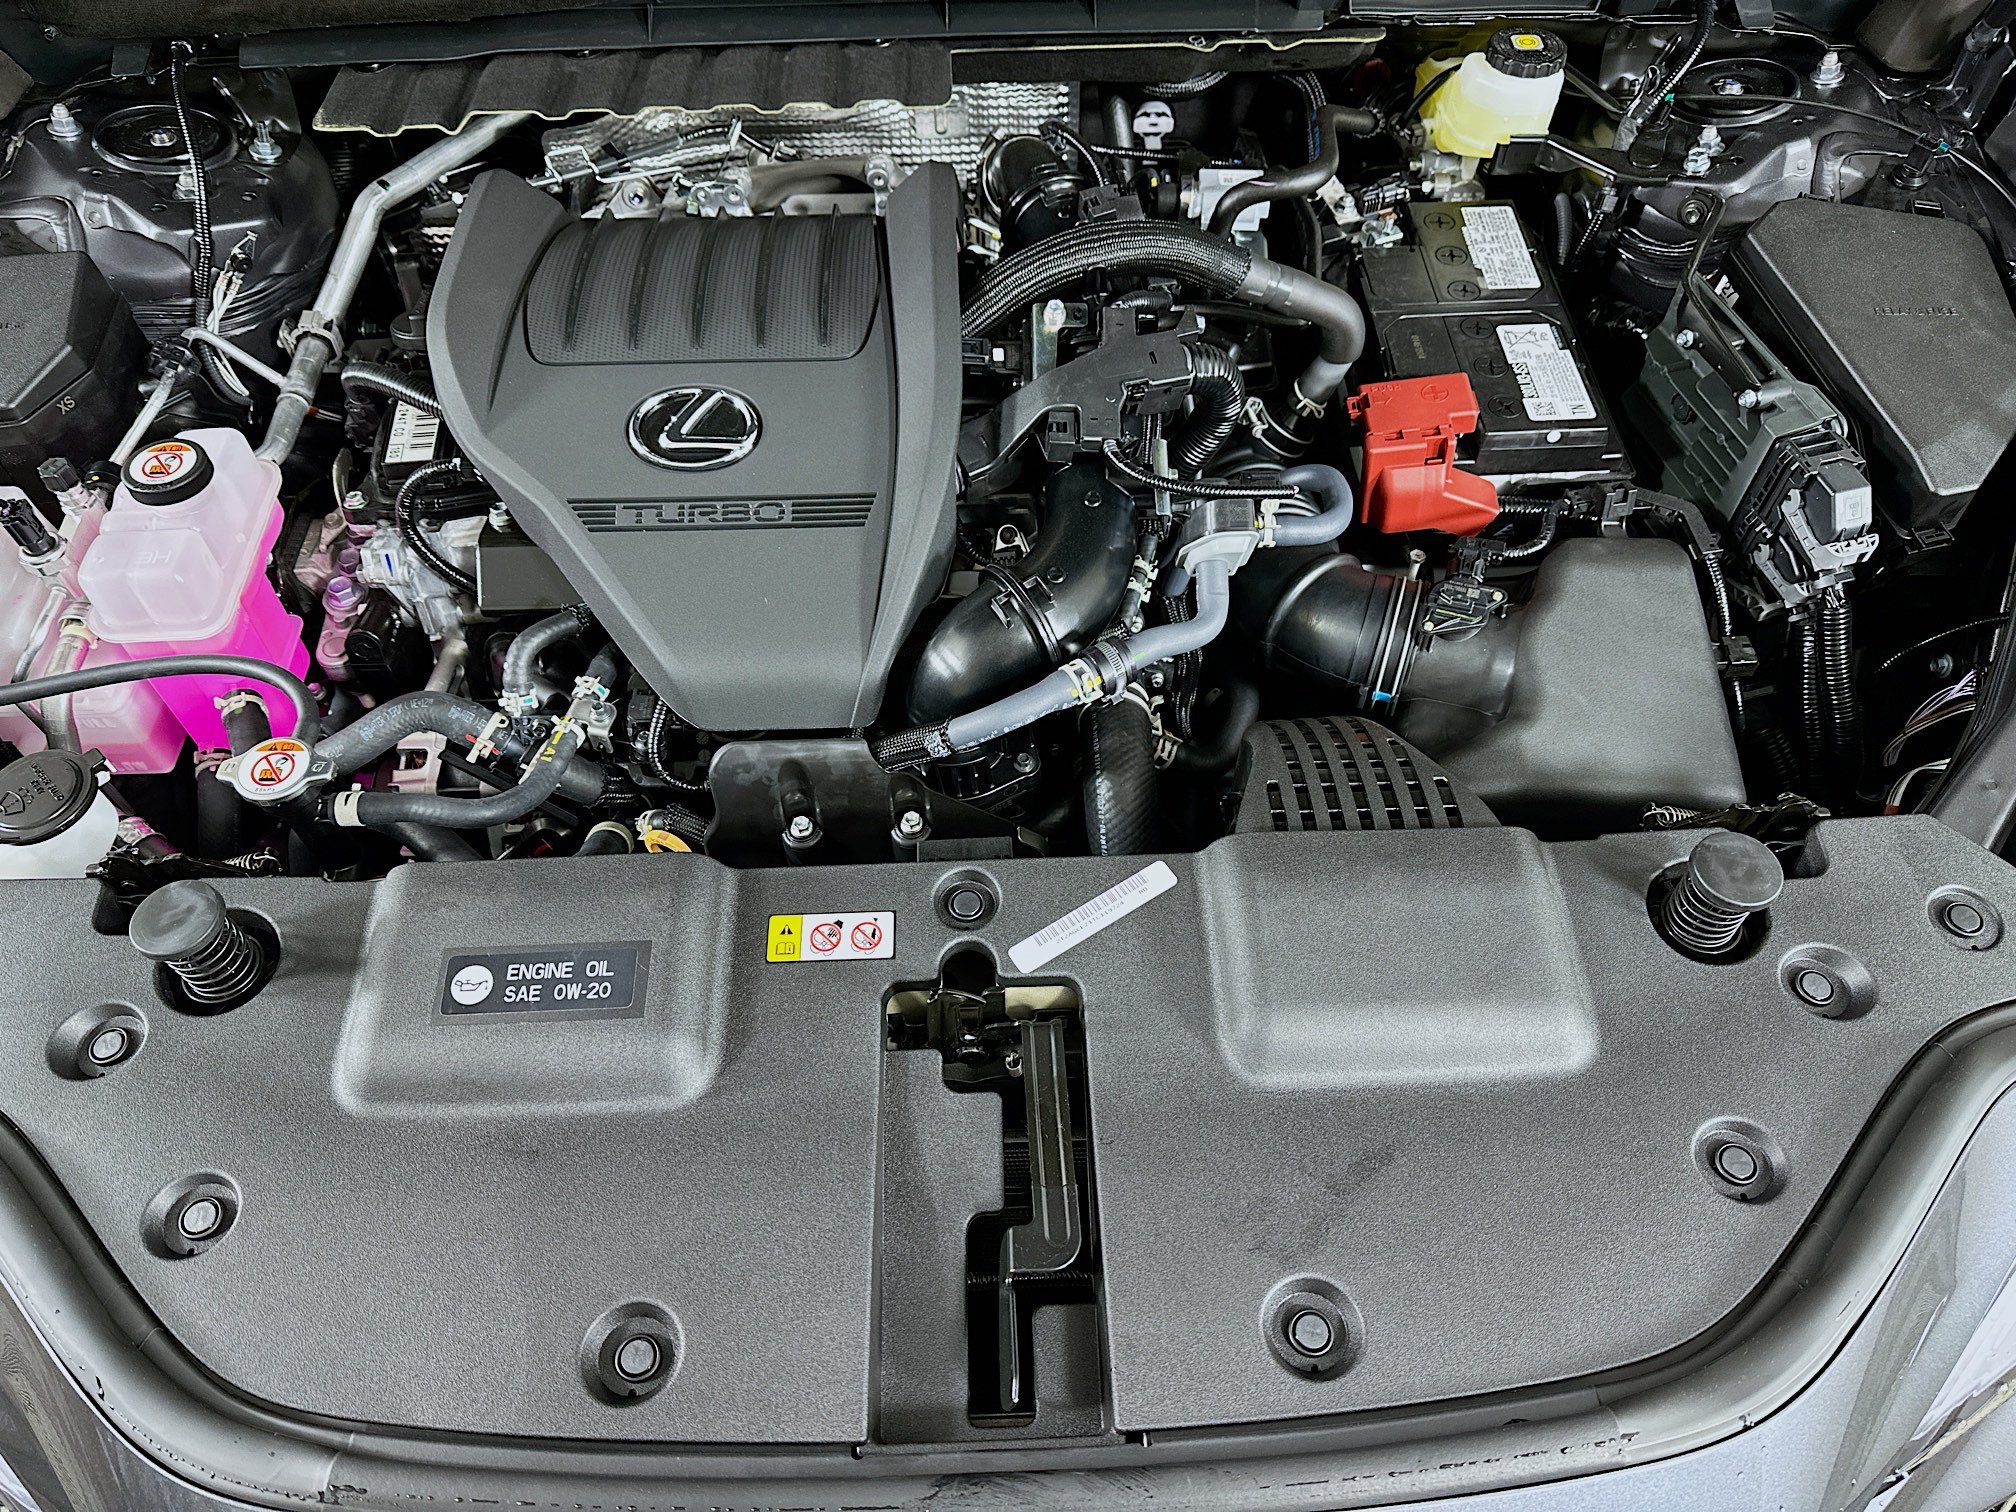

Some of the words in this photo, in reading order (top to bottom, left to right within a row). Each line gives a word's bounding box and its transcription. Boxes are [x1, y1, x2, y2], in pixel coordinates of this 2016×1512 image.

[620, 501, 788, 524] TURBO
[506, 962, 574, 980] ENGINE
[585, 960, 614, 977] OIL
[503, 985, 542, 1003] SAE
[553, 982, 612, 1001] 0W-20
